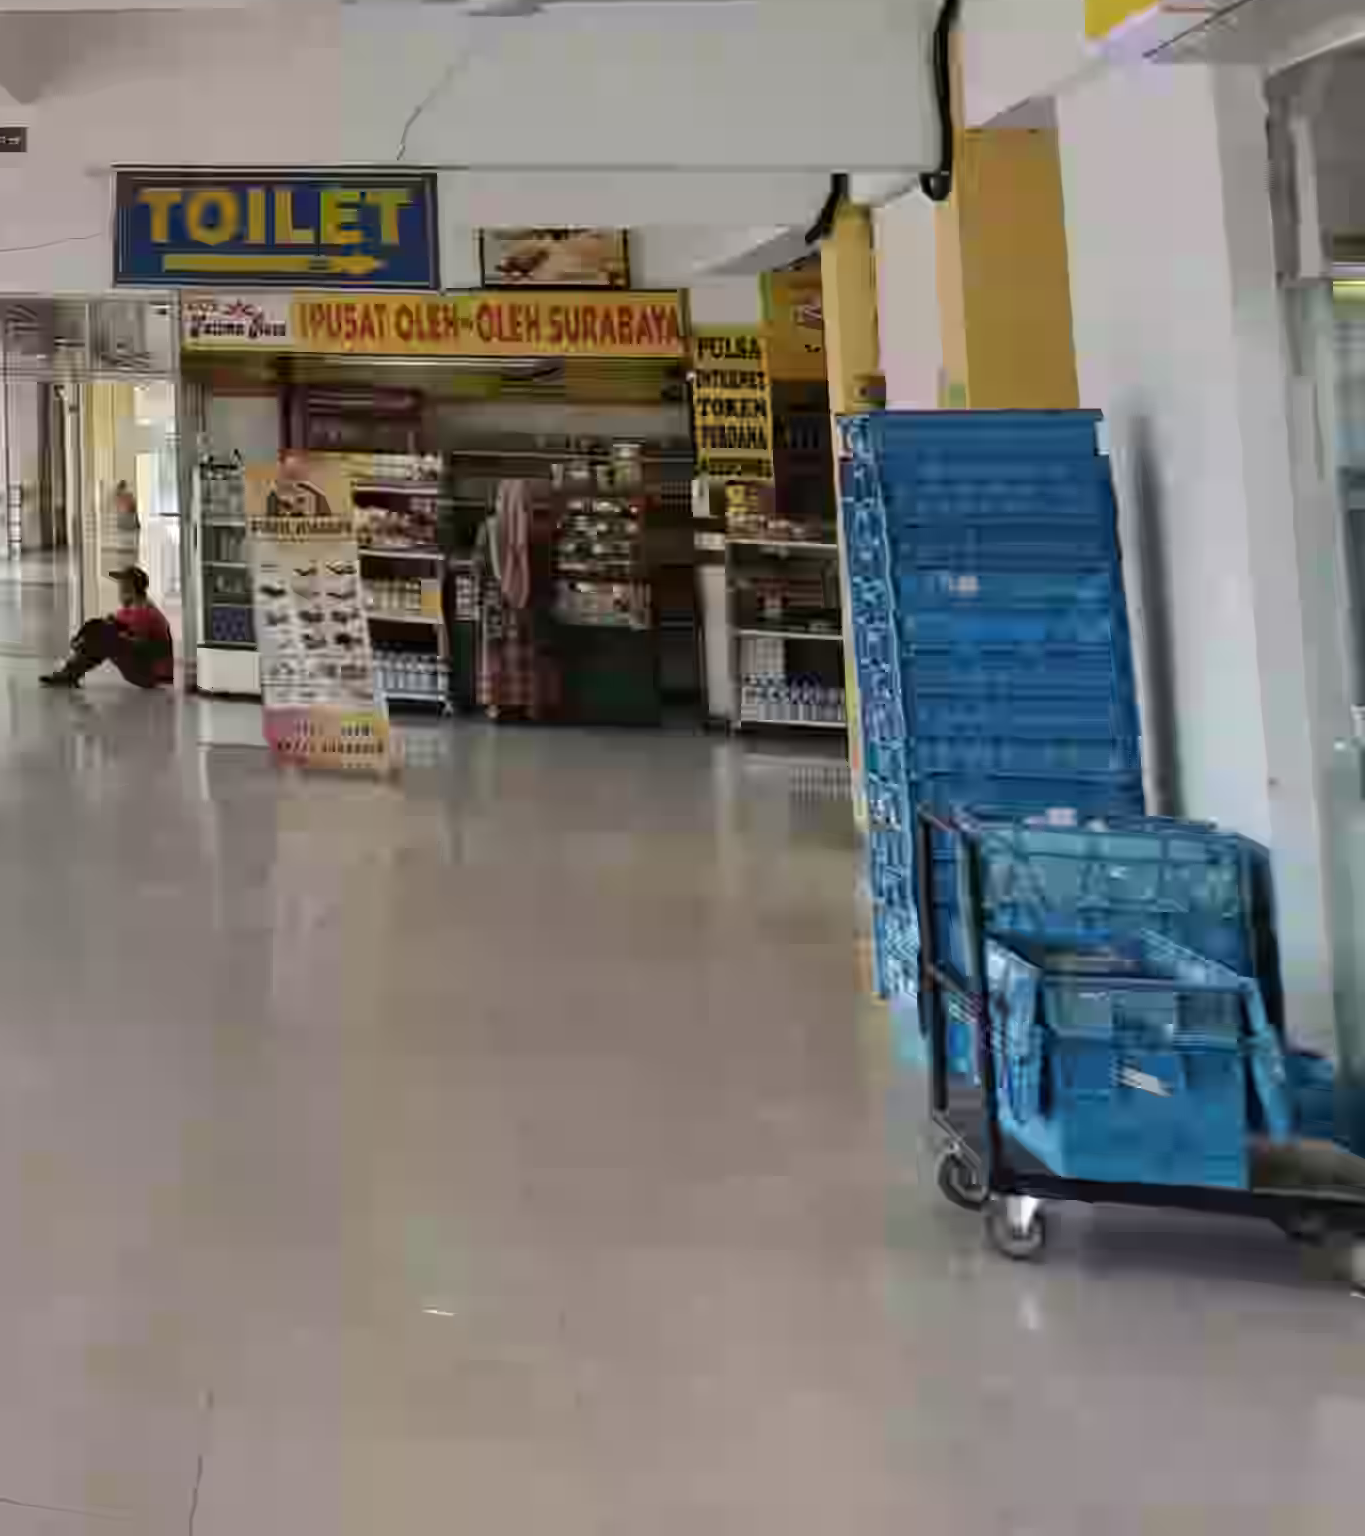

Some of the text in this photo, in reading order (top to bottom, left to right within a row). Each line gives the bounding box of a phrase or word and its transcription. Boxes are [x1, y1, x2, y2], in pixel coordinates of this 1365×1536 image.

[136, 186, 414, 246] TOILET
[547, 304, 678, 346] SURABAYA
[697, 398, 768, 419] TOKEN
